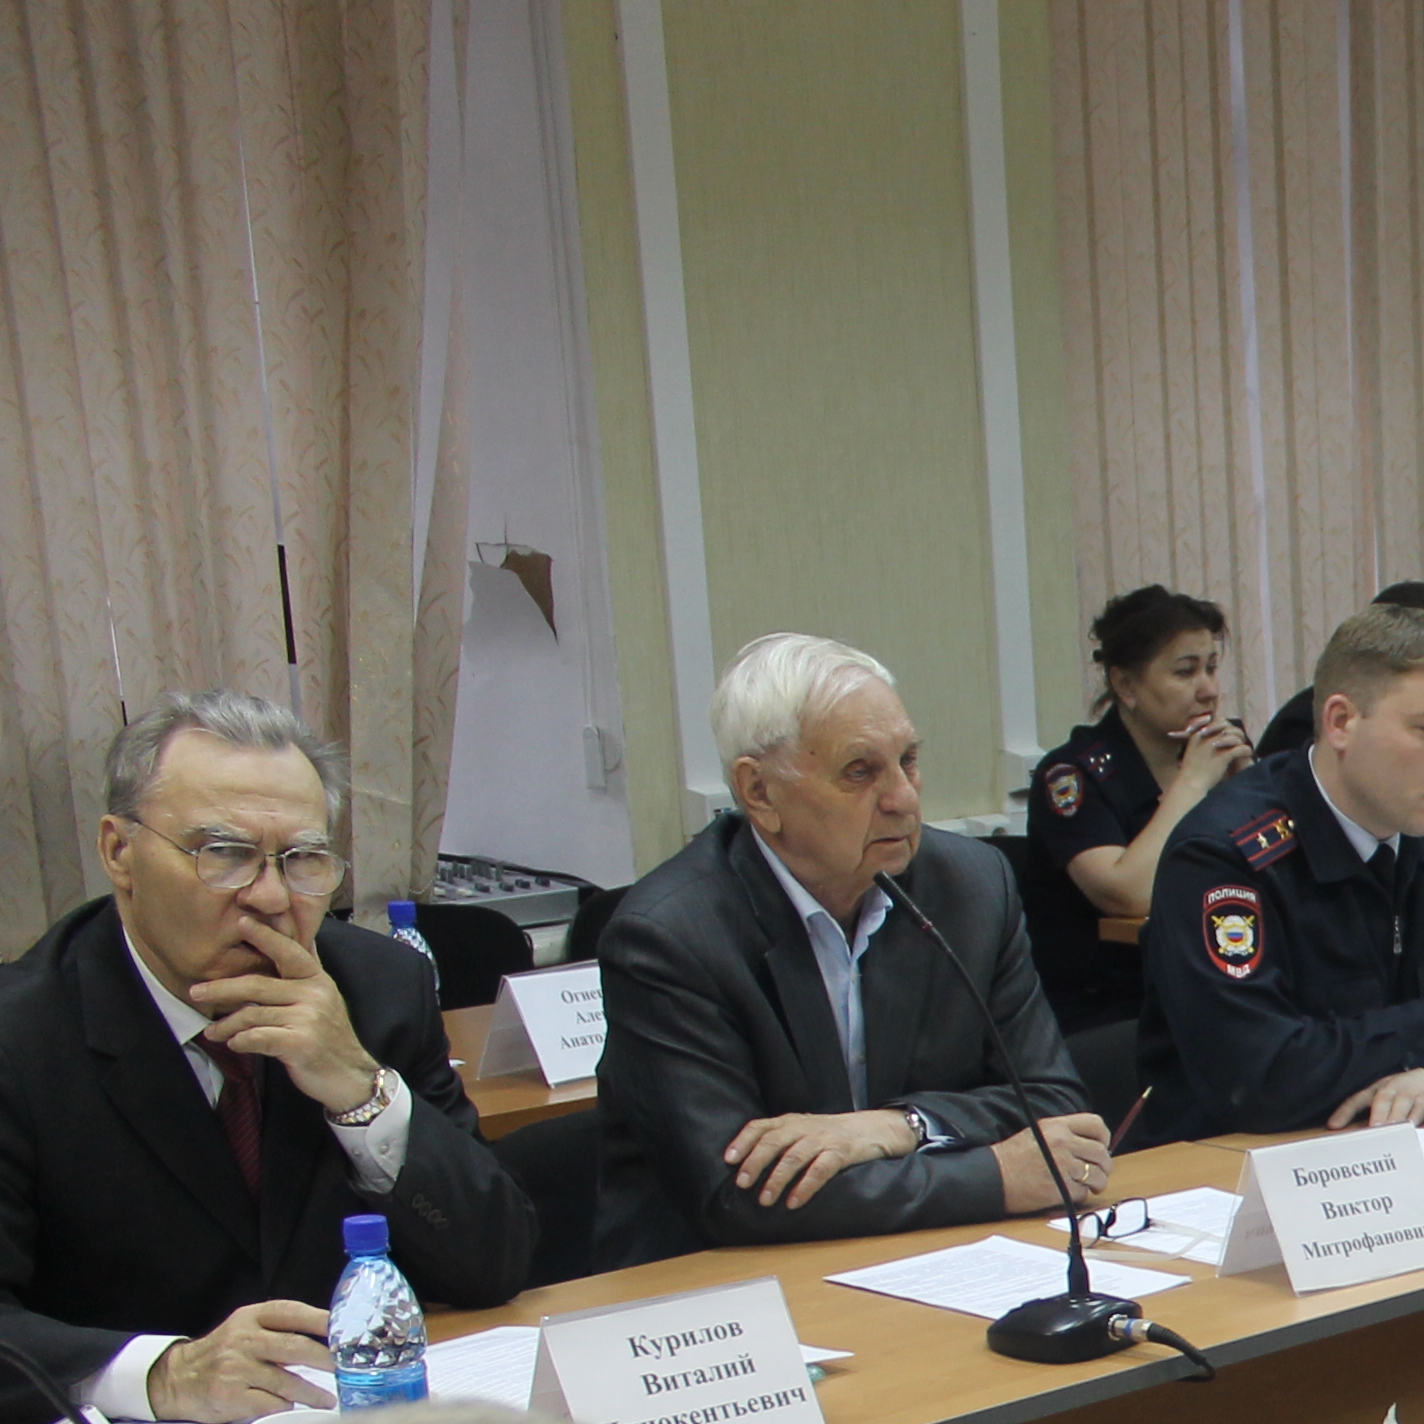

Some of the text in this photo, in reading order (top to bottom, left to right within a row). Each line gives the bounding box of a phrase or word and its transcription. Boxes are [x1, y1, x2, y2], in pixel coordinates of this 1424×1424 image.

[1208, 888, 1256, 904] ПОЛИЦИЯ
[1226, 963, 1251, 979] МВД
[576, 1010, 605, 1025] Але
[561, 1033, 605, 1050] Анато
[1291, 1153, 1397, 1188] Боровский
[1320, 1195, 1394, 1220] Виктор
[626, 1320, 744, 1360] Курилов
[640, 1353, 757, 1396] Виталий
